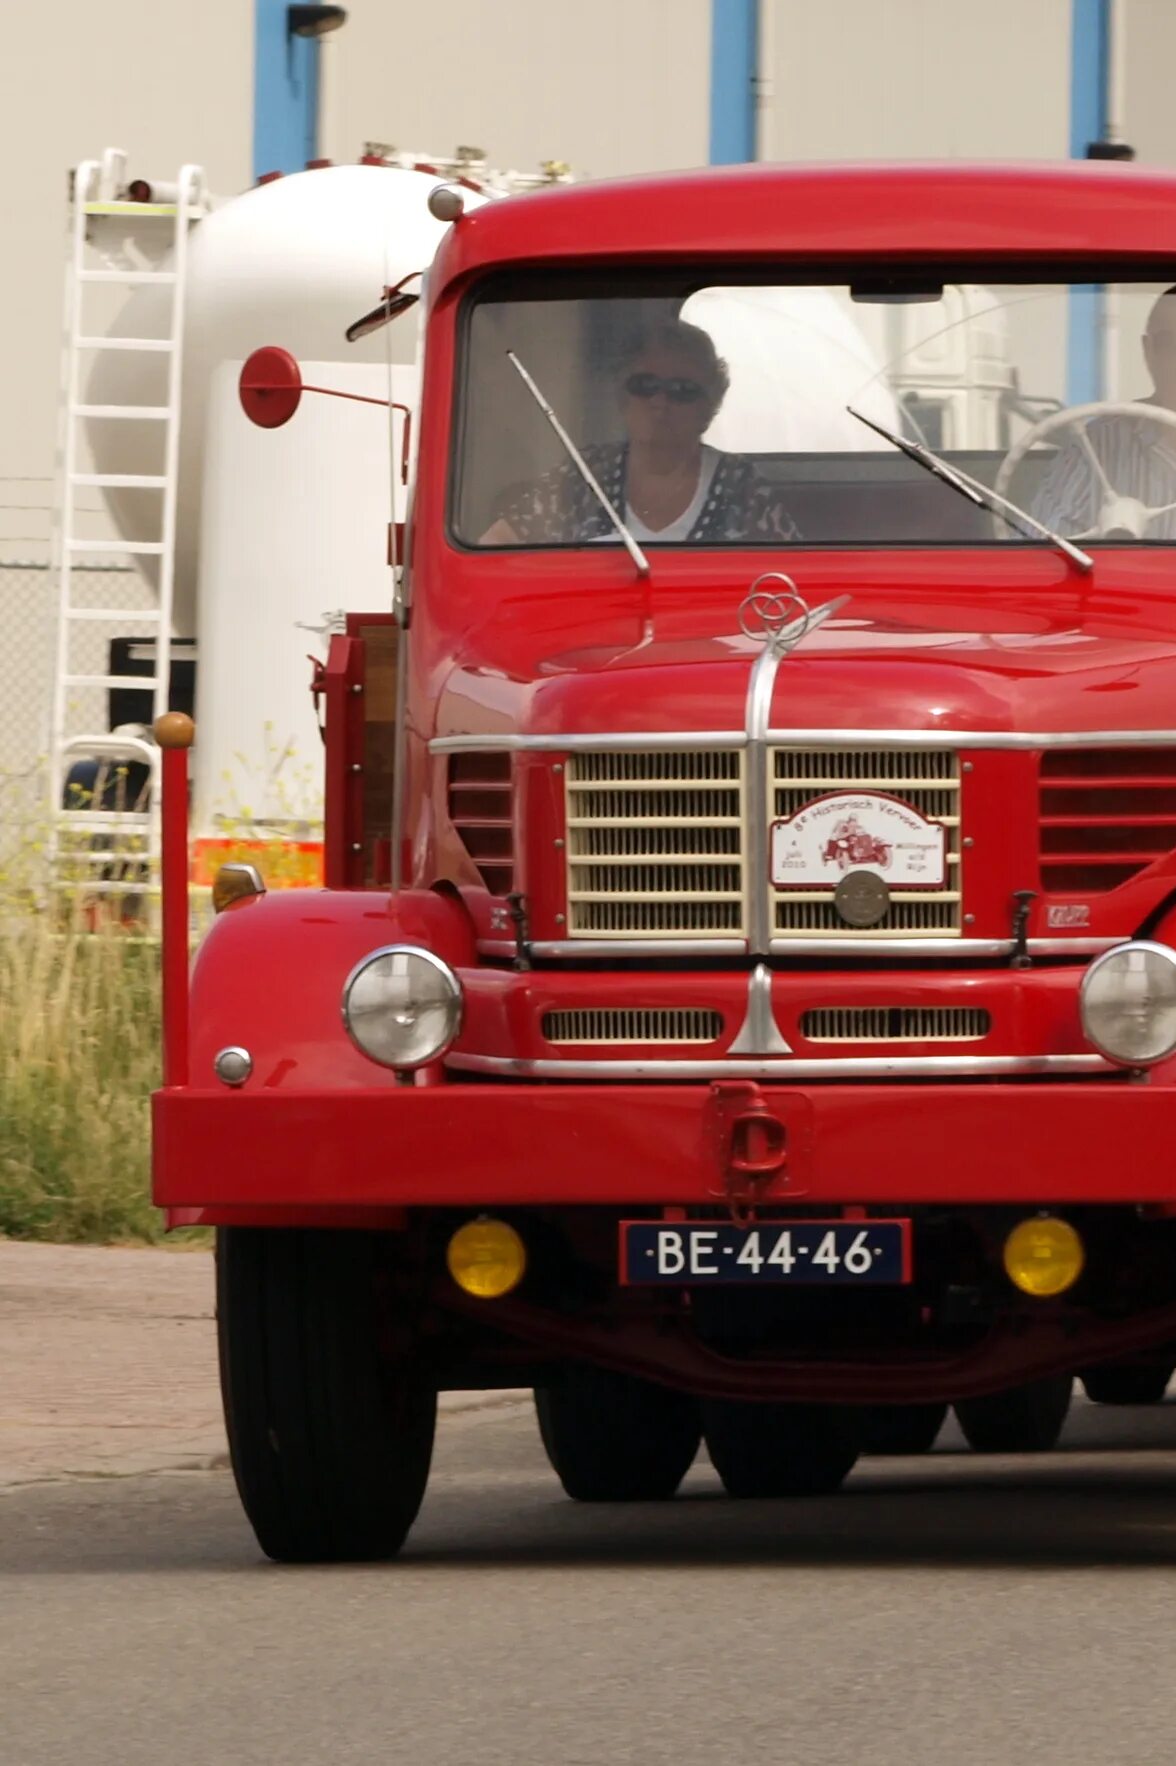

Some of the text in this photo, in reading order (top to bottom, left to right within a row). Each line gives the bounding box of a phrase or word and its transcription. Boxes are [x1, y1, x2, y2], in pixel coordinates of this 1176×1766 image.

[812, 799, 873, 819] Historisch
[879, 802, 922, 831] Vervoer
[785, 850, 802, 860] juli
[657, 1230, 873, 1274] BE-44-46
